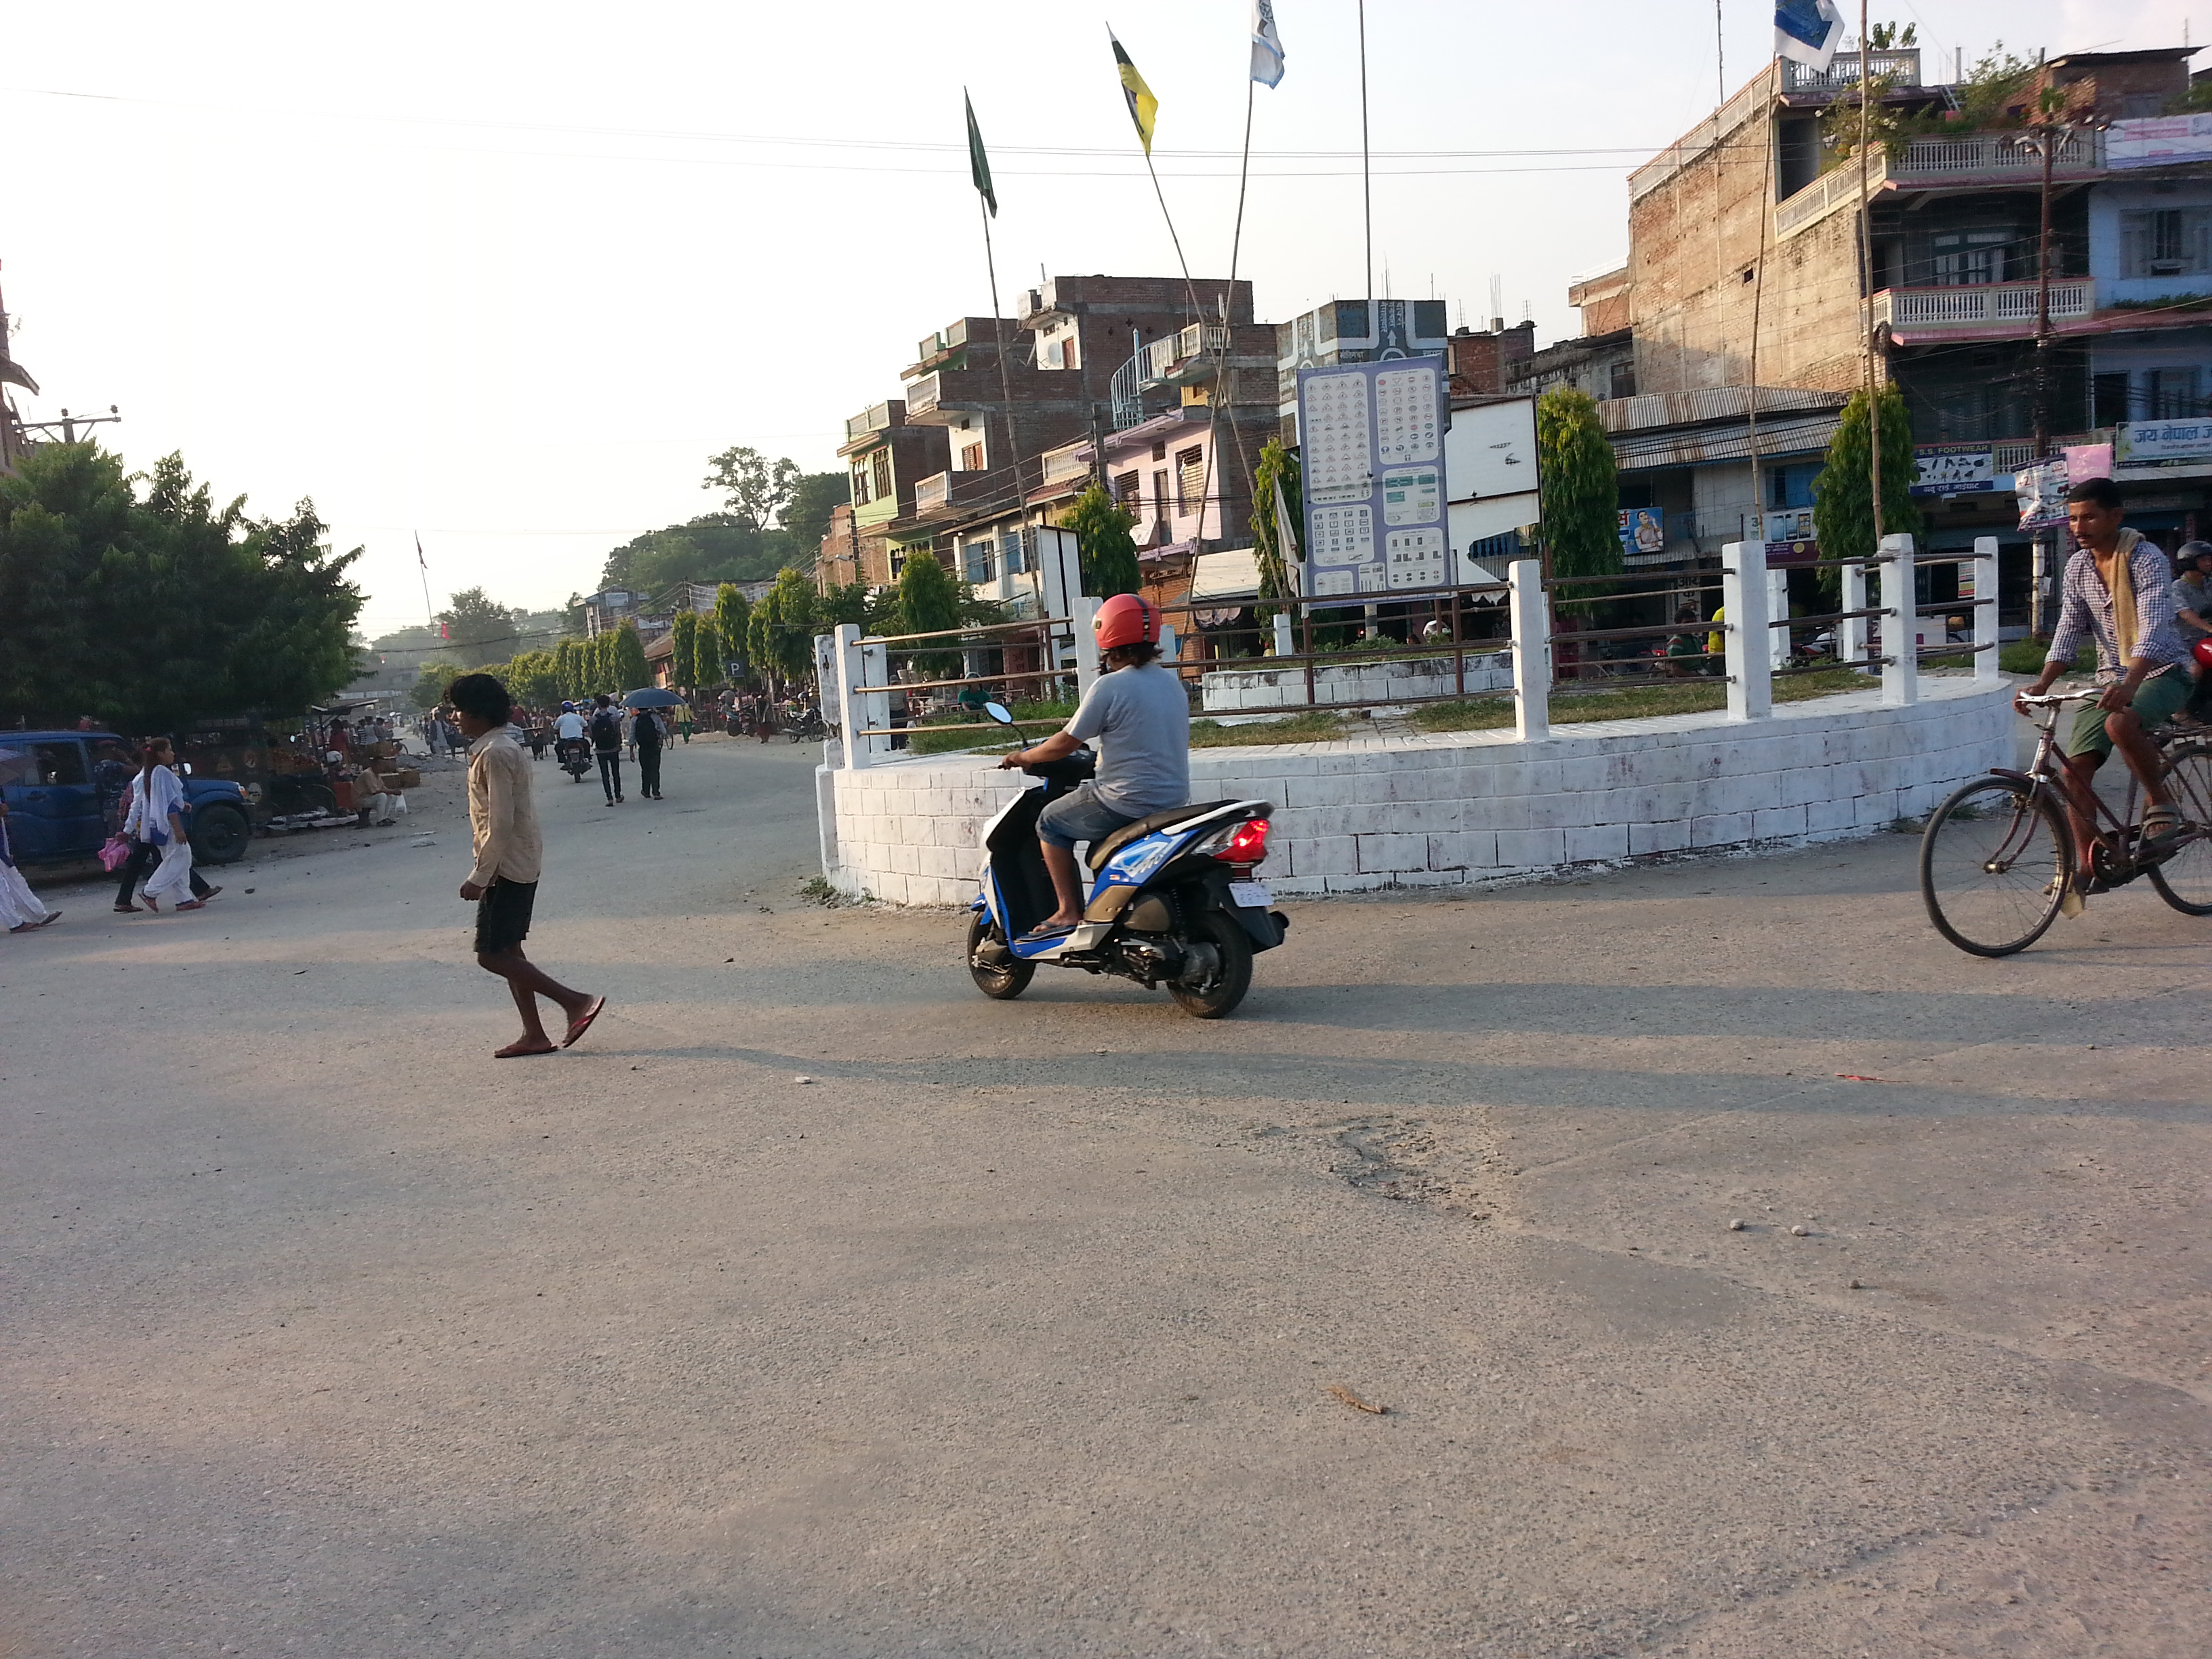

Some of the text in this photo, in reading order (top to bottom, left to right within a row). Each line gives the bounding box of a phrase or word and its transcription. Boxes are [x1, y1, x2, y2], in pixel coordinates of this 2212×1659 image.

[2134, 430, 2158, 443] जय
[2163, 424, 2199, 441] नेपाल
[1938, 445, 1988, 453] FOOTWEAR
[731, 663, 739, 675] P
